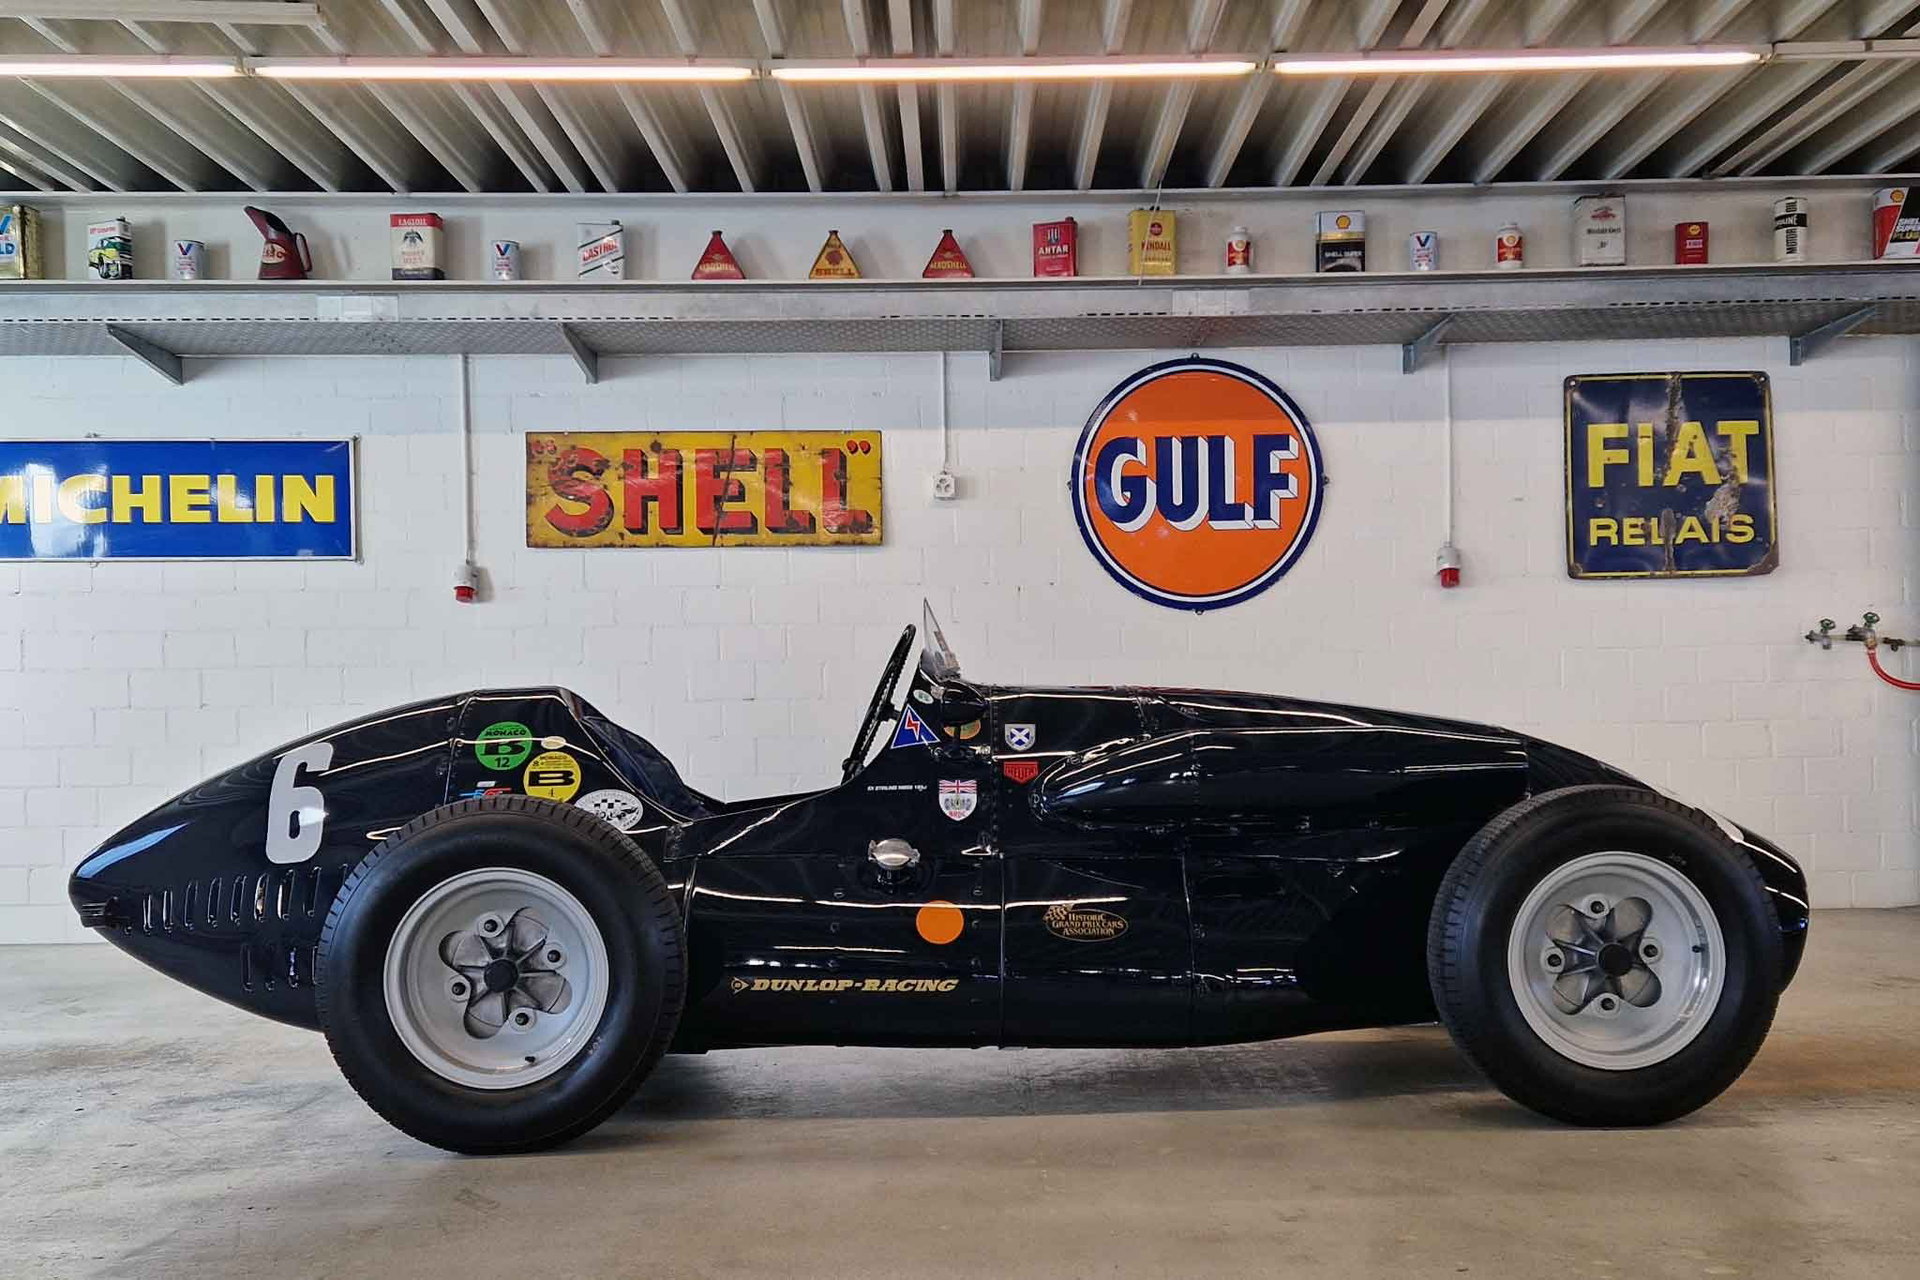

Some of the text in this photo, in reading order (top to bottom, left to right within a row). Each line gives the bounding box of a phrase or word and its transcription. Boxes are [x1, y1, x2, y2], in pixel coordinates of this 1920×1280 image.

[1785, 228, 1798, 255] MOTOR
[1038, 244, 1069, 256] ANTAR
[1587, 420, 1760, 488] FIAT
[1095, 434, 1299, 532] GULF
[1589, 514, 1755, 546] RELAIS
[485, 728, 527, 737] MONACO
[494, 757, 511, 769] 12
[528, 771, 576, 787] B
[265, 741, 334, 864] 6
[1068, 913, 1106, 921] HISTORIC
[1052, 920, 1124, 929] GRAND PRIX CARS
[1063, 928, 1115, 936] ASSOCIATION
[749, 979, 959, 992] DUNLOP-RACING
